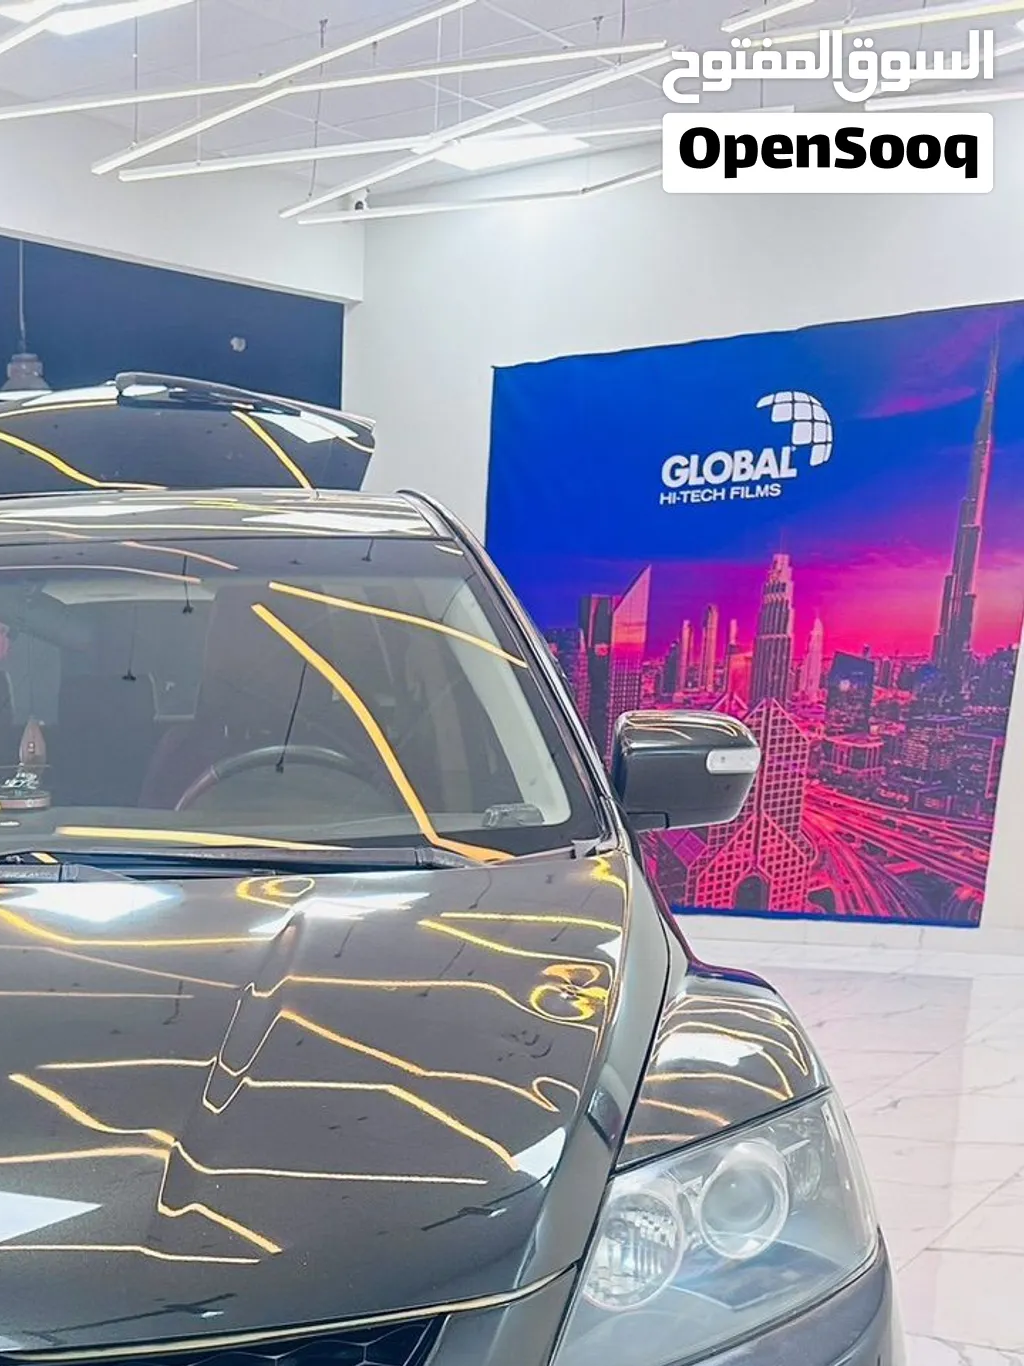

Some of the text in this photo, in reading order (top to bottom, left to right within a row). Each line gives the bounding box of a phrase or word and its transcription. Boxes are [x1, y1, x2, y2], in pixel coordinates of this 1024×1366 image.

[661, 446, 798, 488] GLOBAL
[659, 483, 782, 505] HI-TECH FILMS
